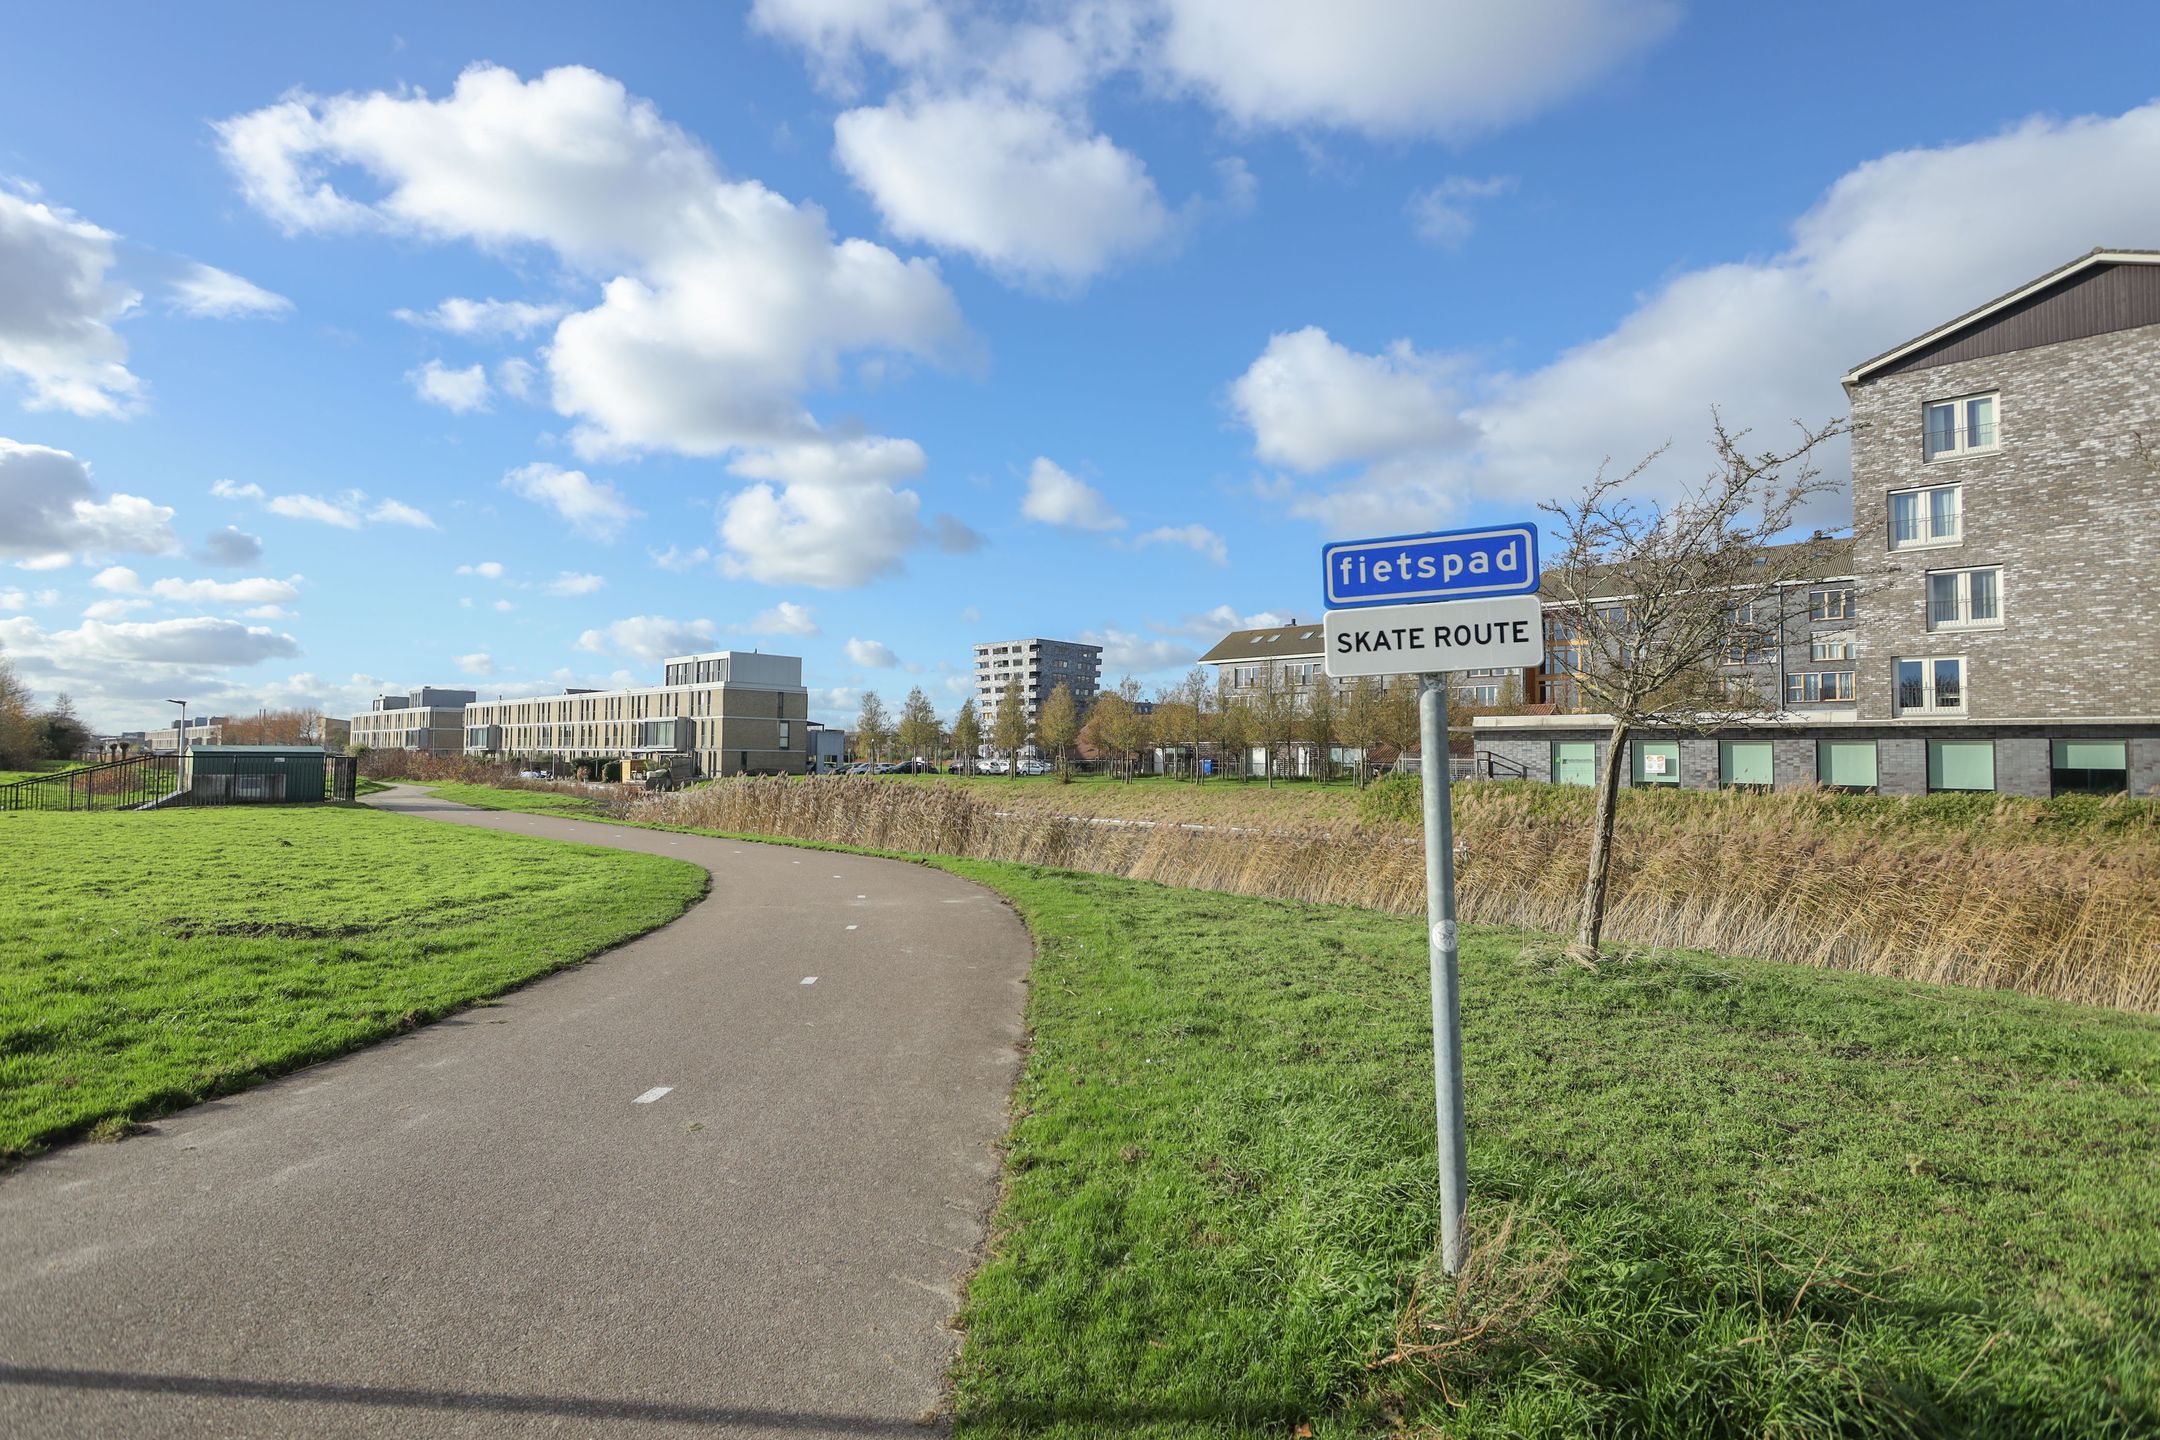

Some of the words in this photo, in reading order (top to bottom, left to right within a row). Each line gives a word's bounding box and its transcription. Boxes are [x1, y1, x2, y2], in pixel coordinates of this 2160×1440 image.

[1340, 541, 1517, 585] fietspad
[1337, 627, 1425, 654] SKATE
[1434, 620, 1529, 648] ROUTE
